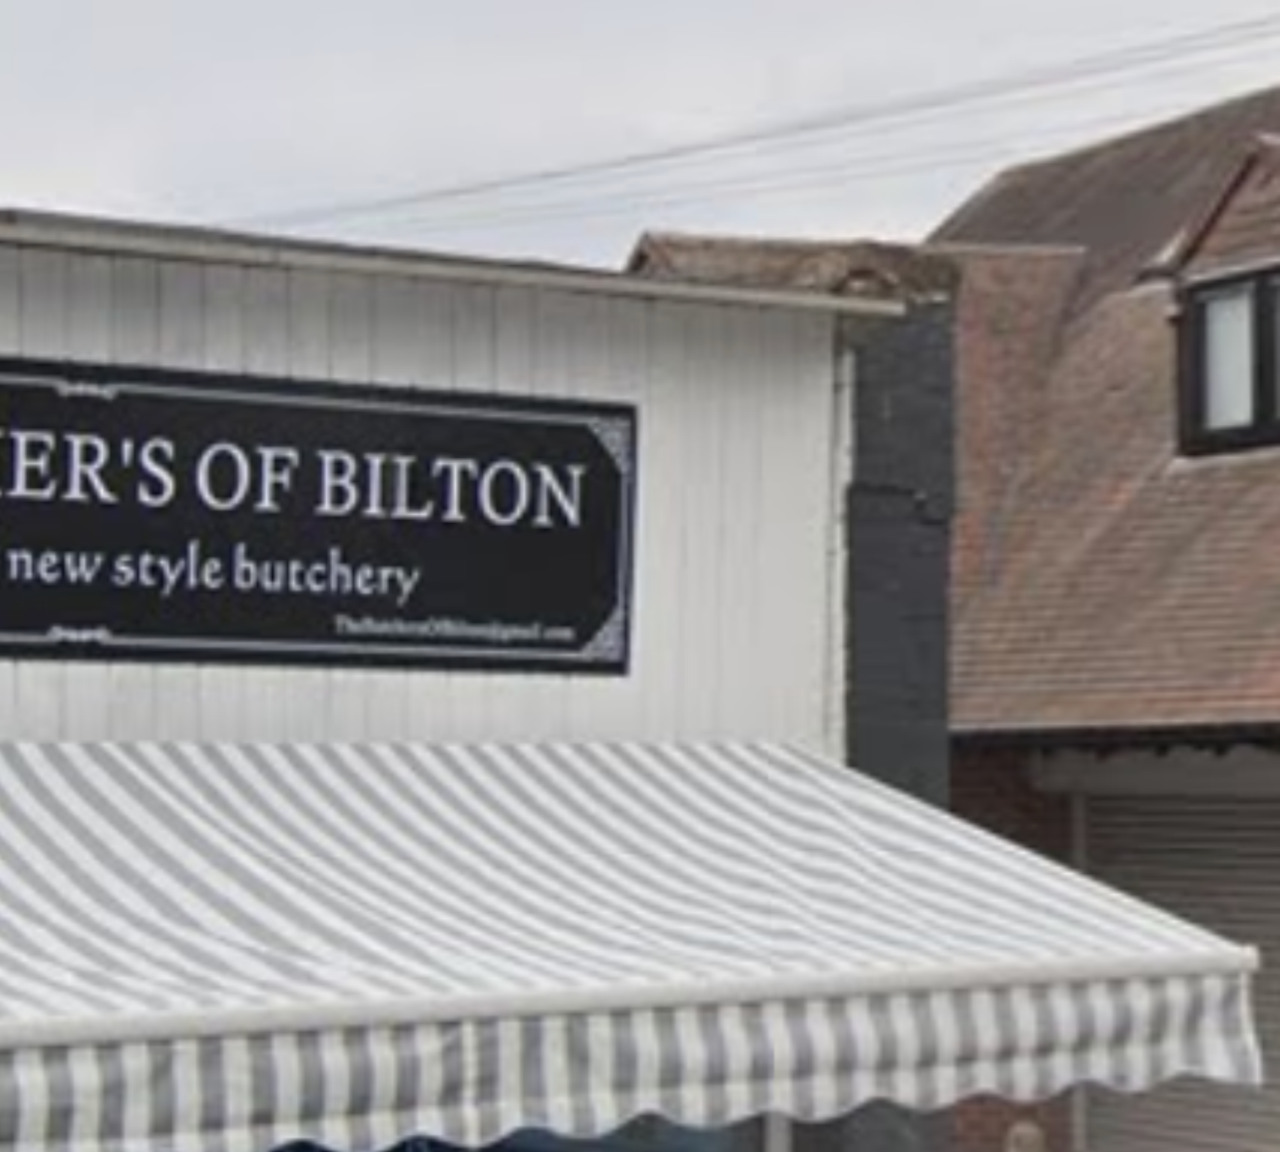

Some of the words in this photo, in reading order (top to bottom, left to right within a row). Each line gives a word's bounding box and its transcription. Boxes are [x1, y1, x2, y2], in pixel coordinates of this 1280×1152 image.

[195, 441, 300, 512] OF
[315, 449, 585, 528] BILTON
[7, 547, 102, 586] new
[113, 540, 224, 596] style
[233, 543, 420, 605] butchery
